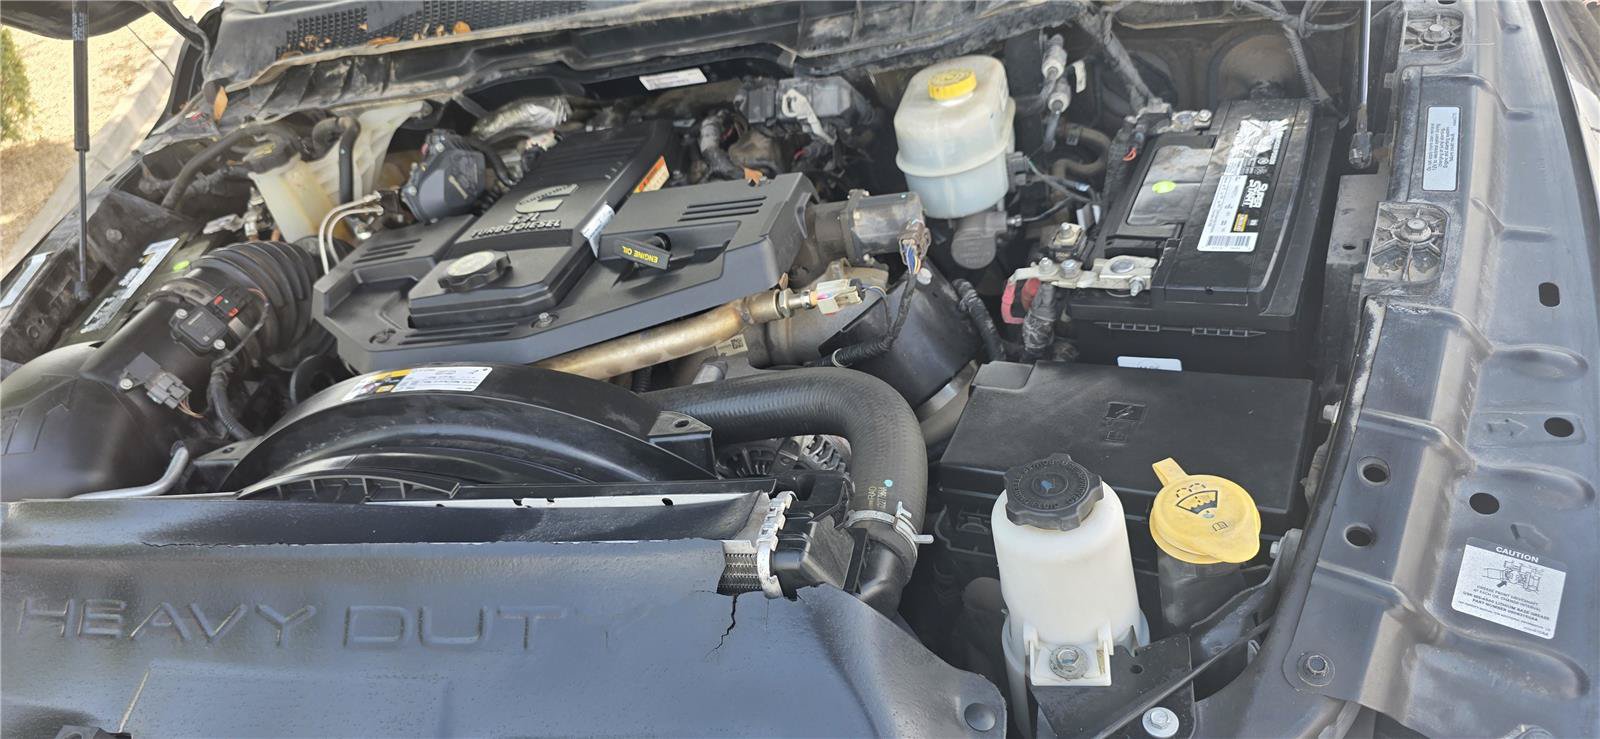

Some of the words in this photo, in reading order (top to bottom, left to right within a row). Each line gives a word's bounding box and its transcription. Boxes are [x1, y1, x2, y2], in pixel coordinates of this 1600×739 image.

[1252, 183, 1269, 208] SUPER
[471, 225, 514, 238] TURBO
[514, 220, 562, 232] DIESEL
[622, 245, 633, 256] OIL
[633, 250, 659, 264] ENGINE
[1495, 546, 1539, 563] CAUTION
[17, 598, 316, 648] HEAVY
